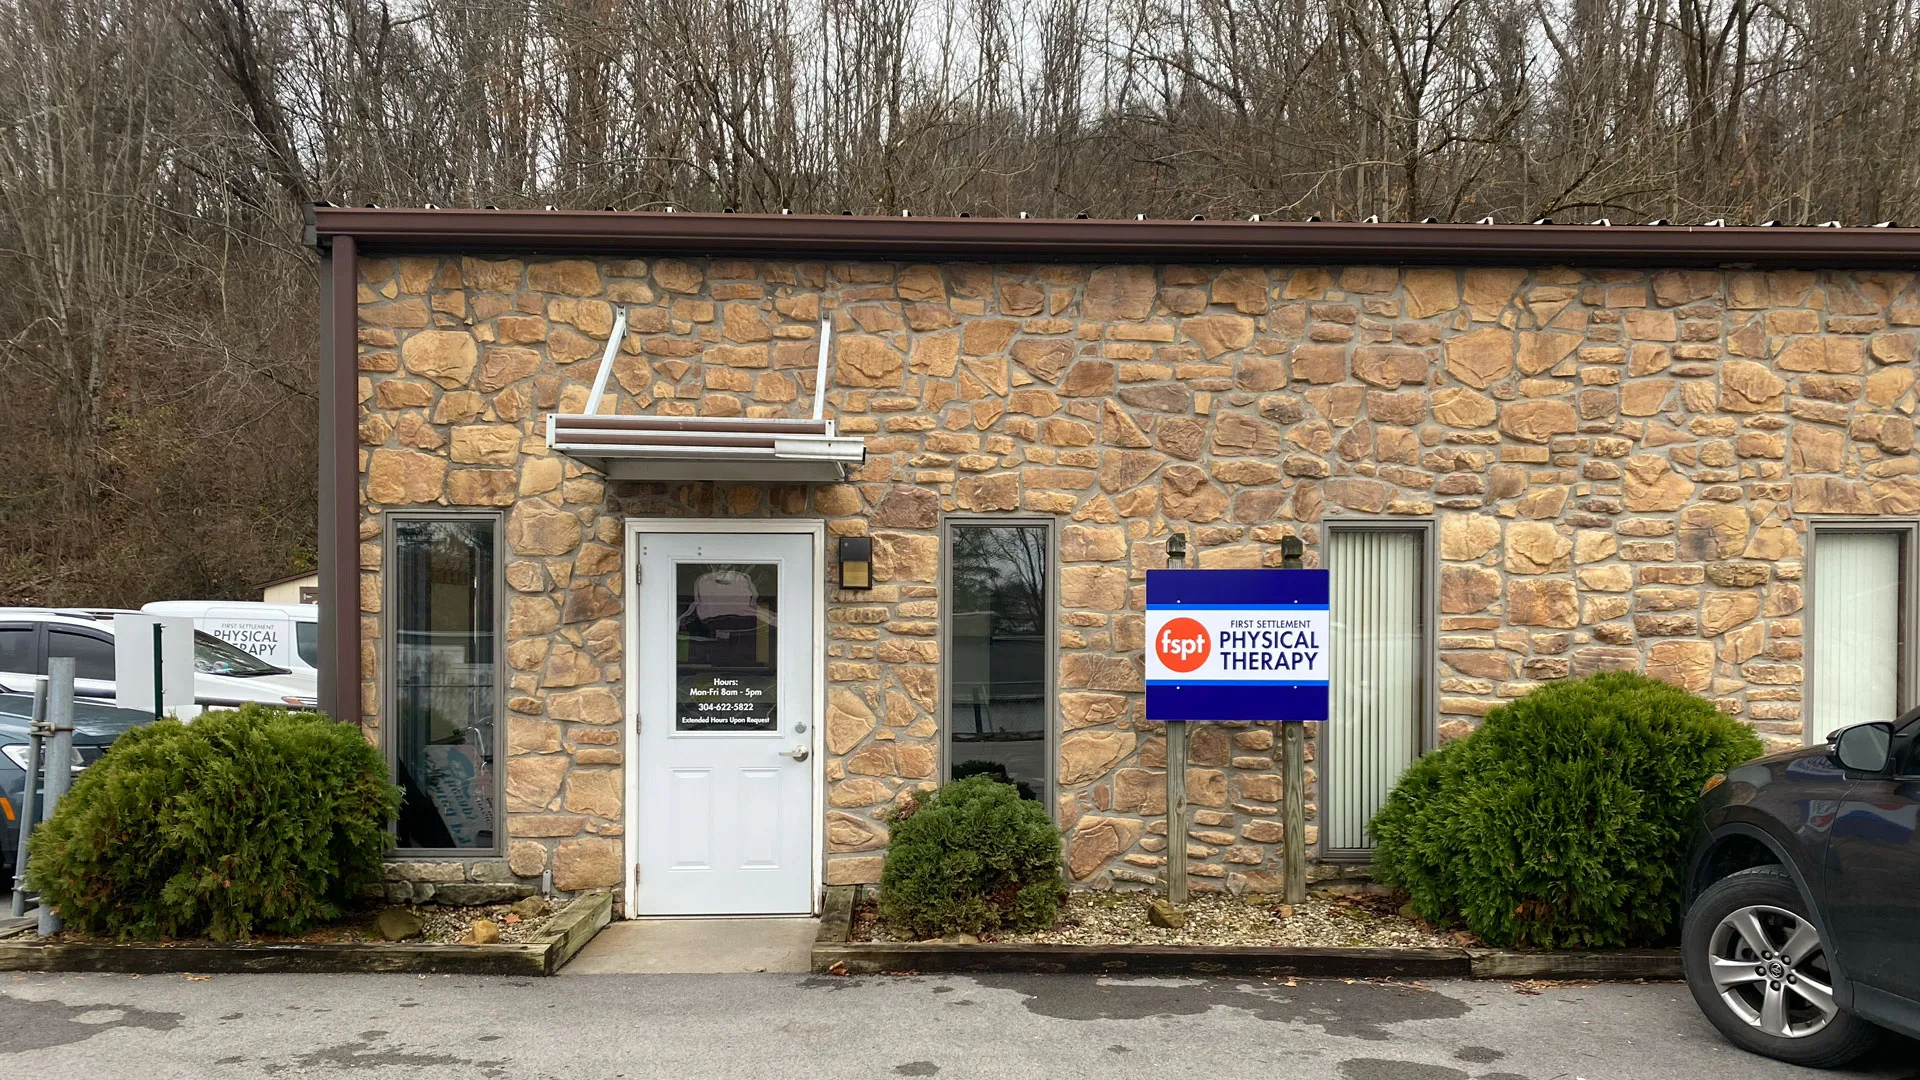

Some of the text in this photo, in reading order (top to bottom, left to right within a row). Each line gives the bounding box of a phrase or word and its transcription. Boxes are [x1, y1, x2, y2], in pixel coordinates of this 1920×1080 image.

[1230, 619, 1312, 629] FIRST SETTLEMENT
[214, 629, 278, 642] PHYSICAL
[1219, 630, 1319, 649] PHYSICAL
[232, 642, 277, 656] RAPY
[1161, 629, 1206, 661] fspt
[1220, 651, 1319, 671] THERAPY
[713, 678, 739, 686] Hours:
[689, 688, 719, 696] Mon-Fri
[720, 688, 738, 696] 8am
[744, 688, 762, 698] 5pm
[698, 703, 754, 711] 304-622-5822
[681, 716, 710, 724] Extended
[729, 717, 746, 725] Upon
[746, 717, 770, 725] Request
